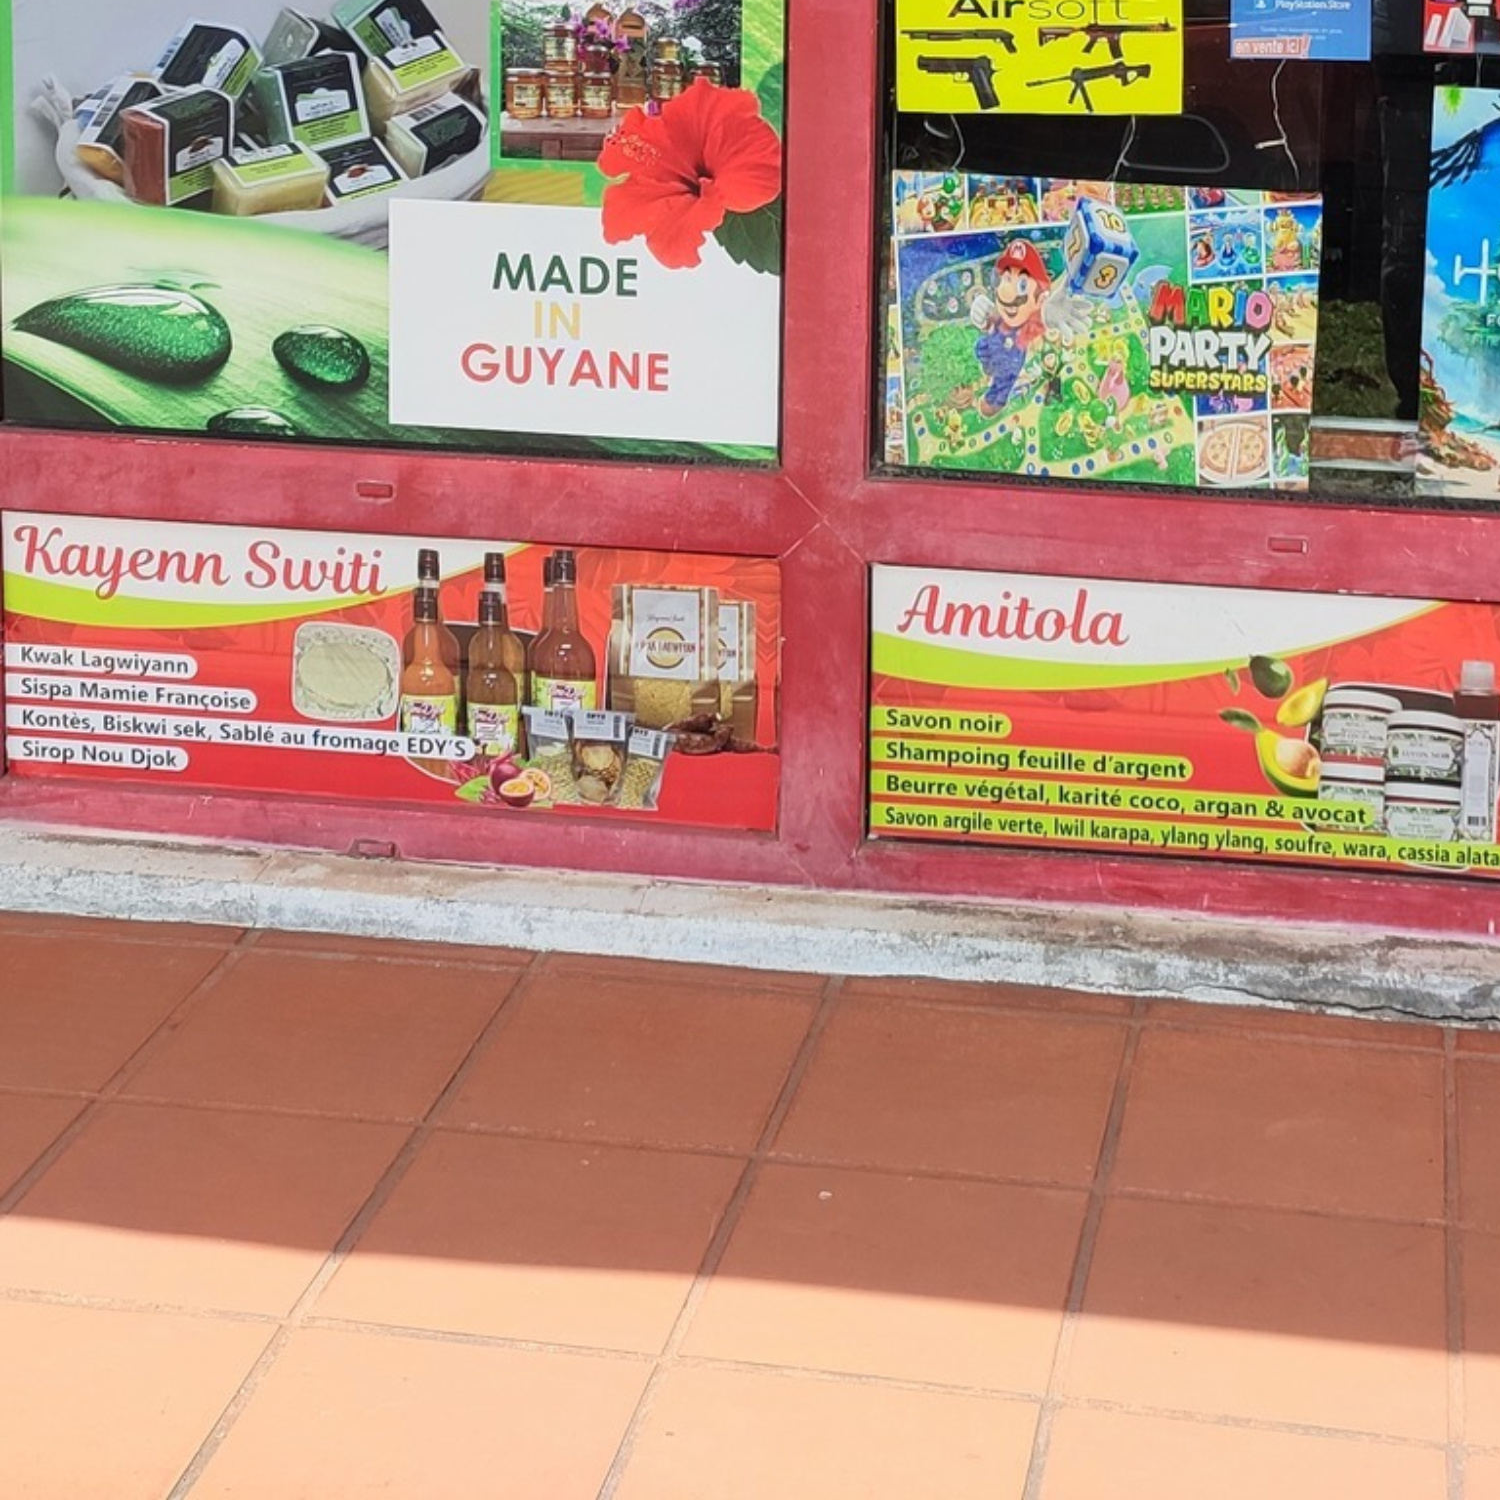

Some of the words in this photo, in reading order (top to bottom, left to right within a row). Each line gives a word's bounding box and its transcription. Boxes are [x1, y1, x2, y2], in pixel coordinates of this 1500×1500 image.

[491, 252, 638, 297] MADE
[533, 300, 581, 341] IN
[1149, 281, 1274, 327] MARIO
[460, 342, 670, 392] GUYANE
[1148, 325, 1273, 371] PARTY
[1149, 369, 1269, 394] SUPERSTARS
[13, 524, 230, 601] Kayenn
[243, 539, 388, 596] Switi
[897, 584, 1130, 647] Amitola
[20, 646, 74, 666] Kwak
[80, 650, 189, 677] Lagwiyann
[20, 677, 73, 701] Sispa
[79, 681, 149, 703] Mamie
[155, 686, 251, 712] Françoise
[21, 708, 96, 734] Kontès,
[102, 714, 167, 736] Biskwi
[173, 720, 213, 742] sek,
[219, 722, 274, 744] Sablé
[280, 729, 305, 745] au
[312, 729, 400, 756] fromage
[407, 735, 466, 758] EDY'S
[885, 708, 952, 730] Savon
[959, 713, 1004, 734] noir
[22, 740, 75, 764] Sirop
[81, 744, 123, 764] Nou
[131, 748, 178, 770] Djok
[885, 742, 1010, 772] Shampoing
[1017, 749, 1086, 773] feuille
[1092, 753, 1187, 781] d'argent
[885, 774, 958, 796] Beurre
[964, 779, 1050, 805] végétal,
[1058, 785, 1122, 808] karité
[1129, 792, 1186, 815] coco,
[1193, 799, 1257, 820] argan
[1265, 799, 1284, 818] &
[1291, 806, 1366, 826] avocat
[885, 807, 938, 828] Savon
[943, 811, 994, 836] argile
[997, 817, 1048, 837] verte,
[1089, 819, 1156, 845] karapa,
[1160, 823, 1209, 850] ylang
[1214, 827, 1269, 855] ylang,
[1275, 836, 1338, 858] soufre,
[1342, 841, 1390, 861] wara,
[1397, 844, 1450, 864] cassia
